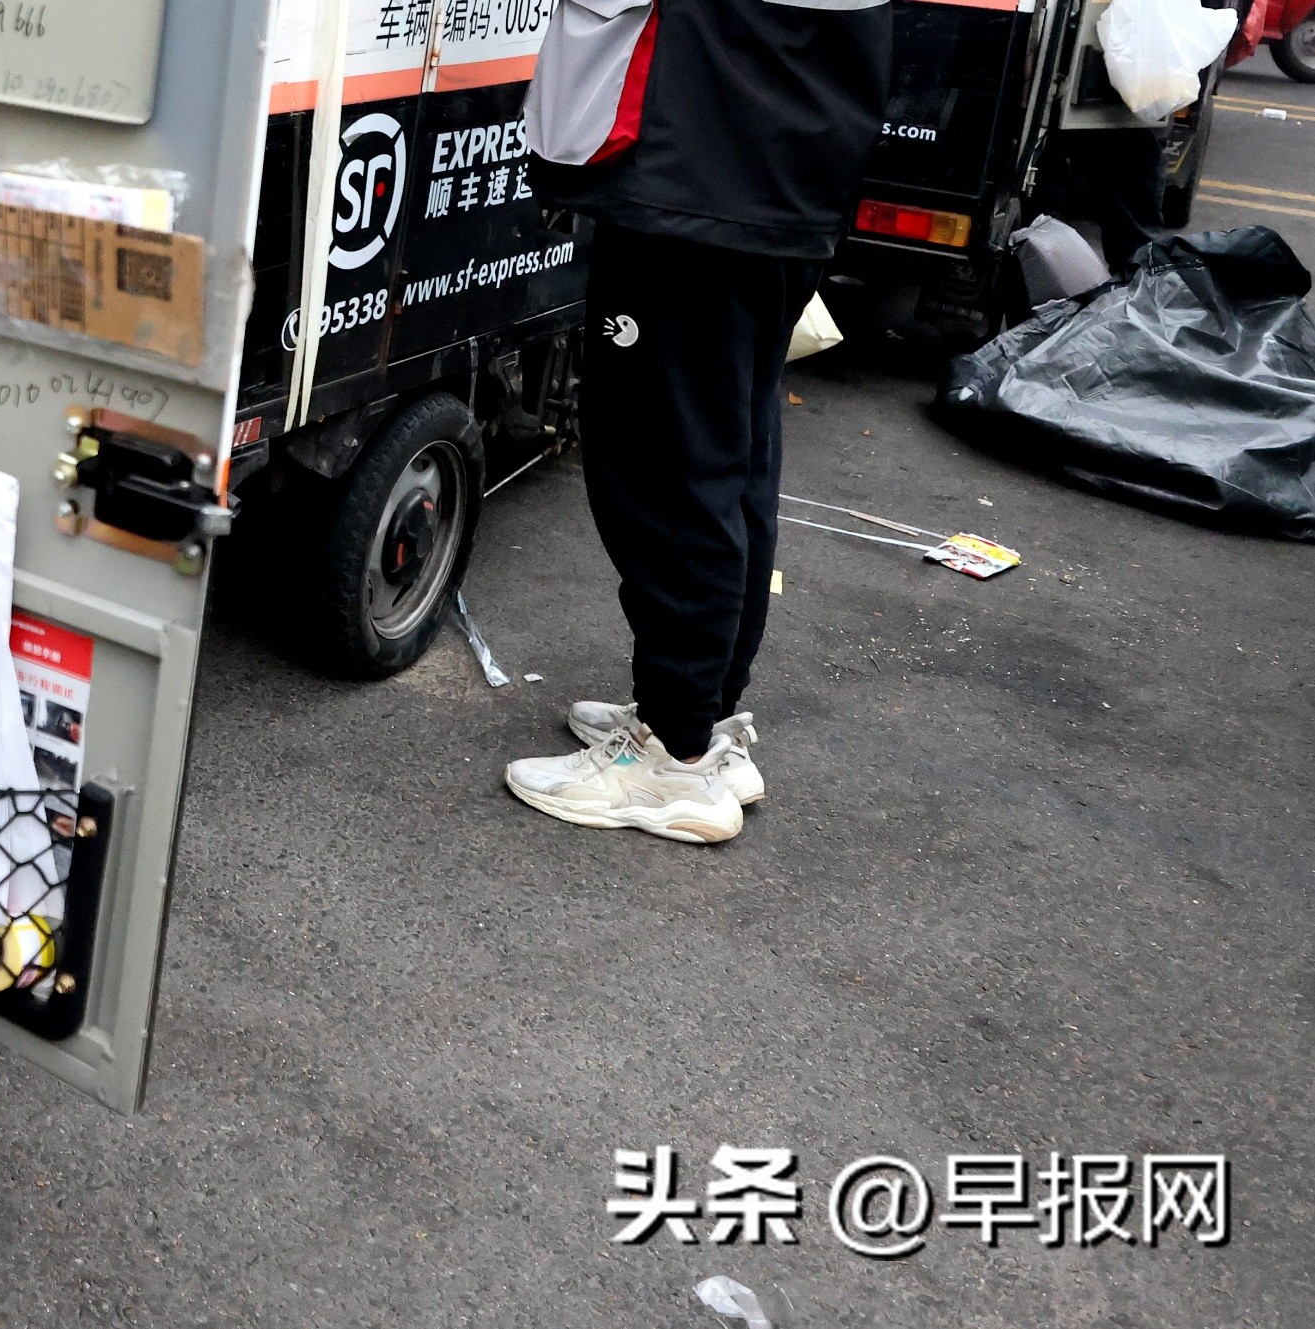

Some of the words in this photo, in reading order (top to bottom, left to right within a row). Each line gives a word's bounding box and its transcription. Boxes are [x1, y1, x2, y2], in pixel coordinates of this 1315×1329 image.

[432, 119, 531, 173] EXPRES
[402, 240, 574, 307] www.sf-express.com
[320, 289, 388, 338] 95338
